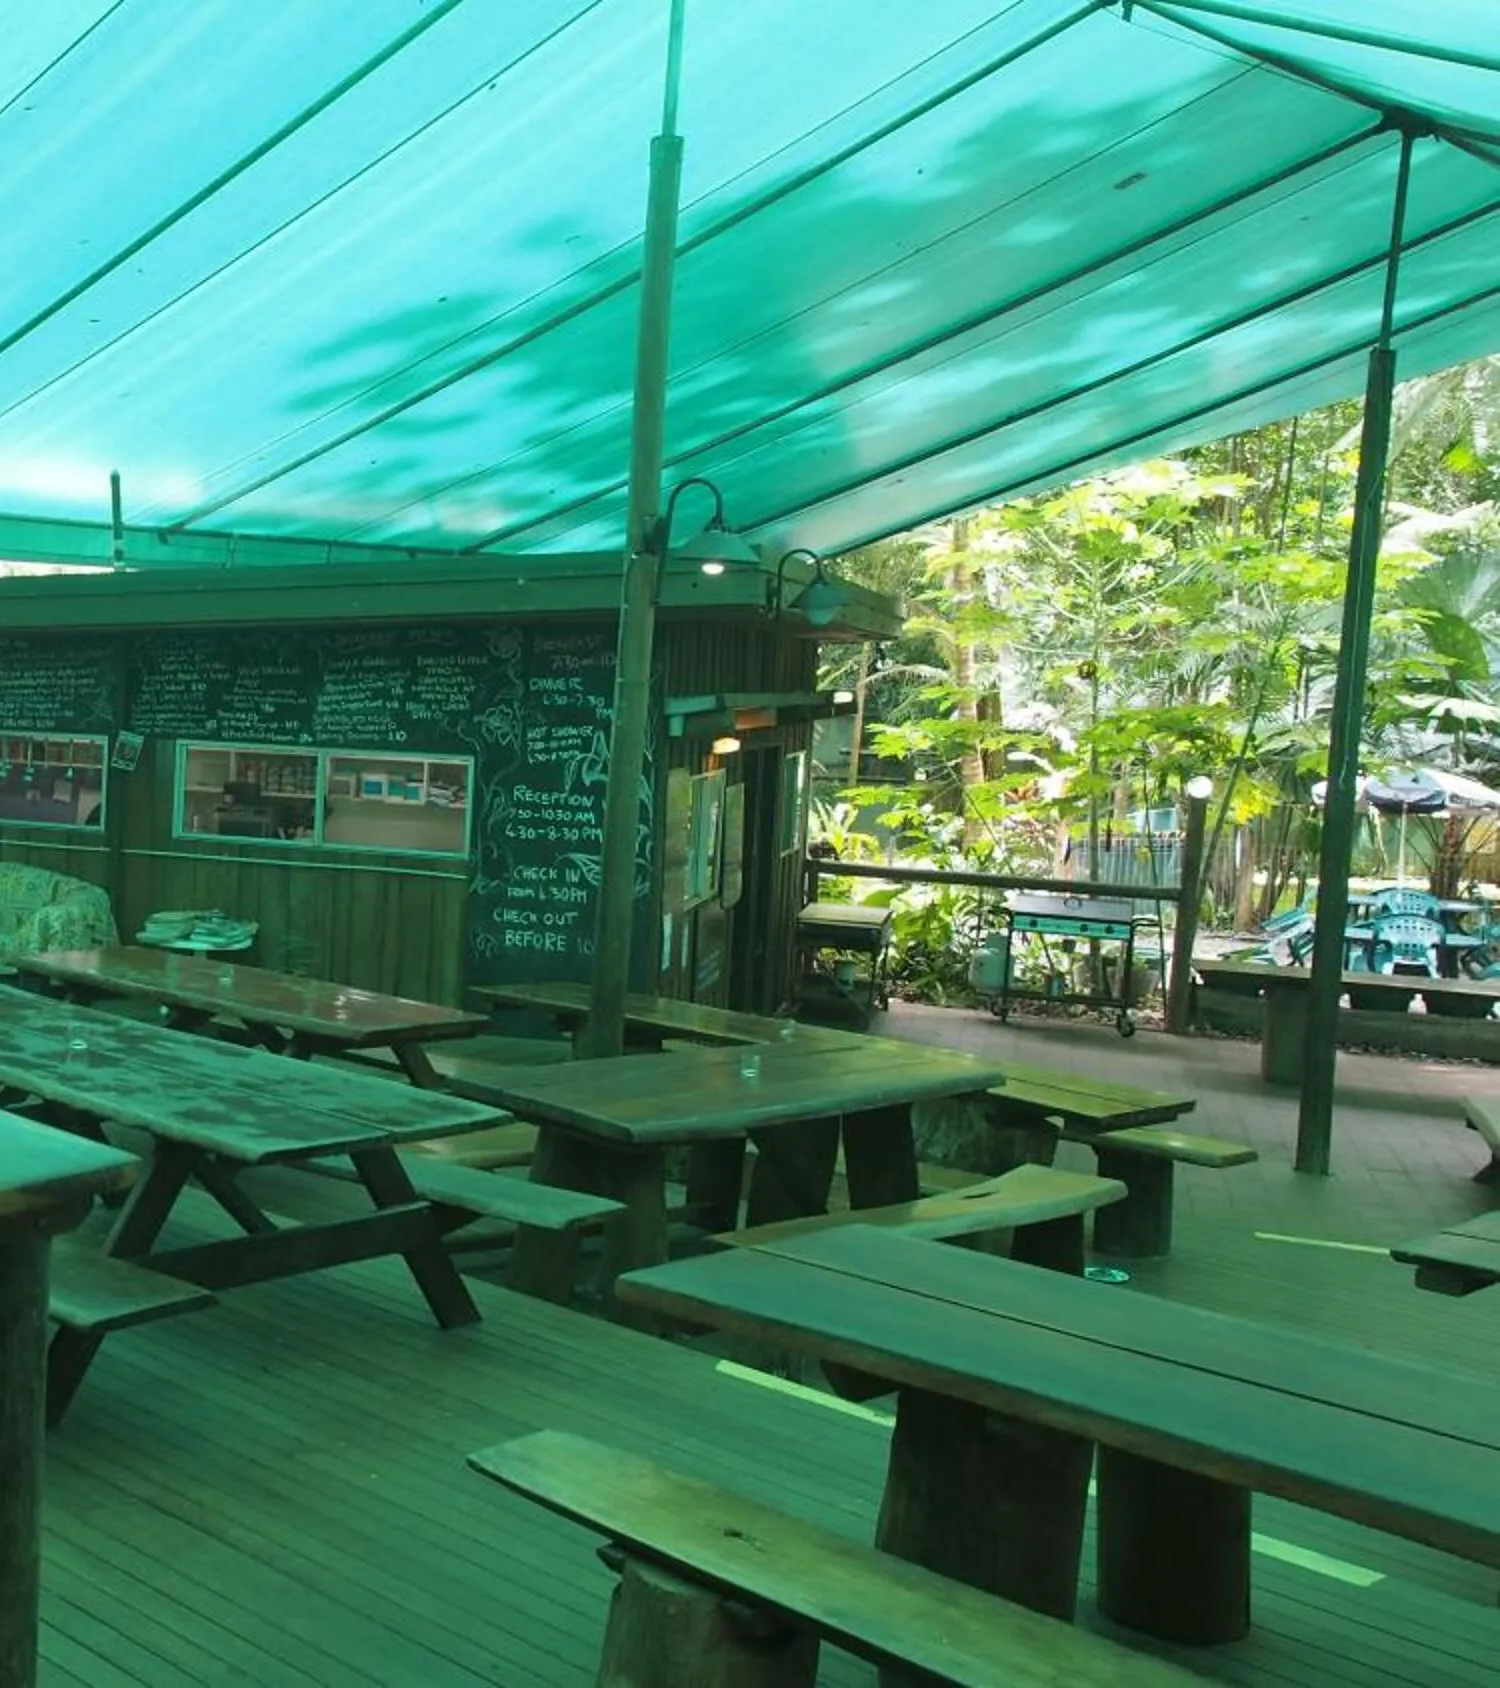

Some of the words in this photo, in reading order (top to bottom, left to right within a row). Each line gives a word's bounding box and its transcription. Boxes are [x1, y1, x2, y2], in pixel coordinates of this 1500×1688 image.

[529, 676, 584, 692] DINNER
[513, 784, 595, 808] RECEPTION
[573, 810, 596, 825] AM
[581, 825, 604, 845] PM
[513, 864, 559, 882] CHECK
[565, 867, 582, 883] IN
[492, 907, 538, 925] CHECK
[542, 910, 580, 926] OUT
[504, 928, 568, 954] BEFORE
